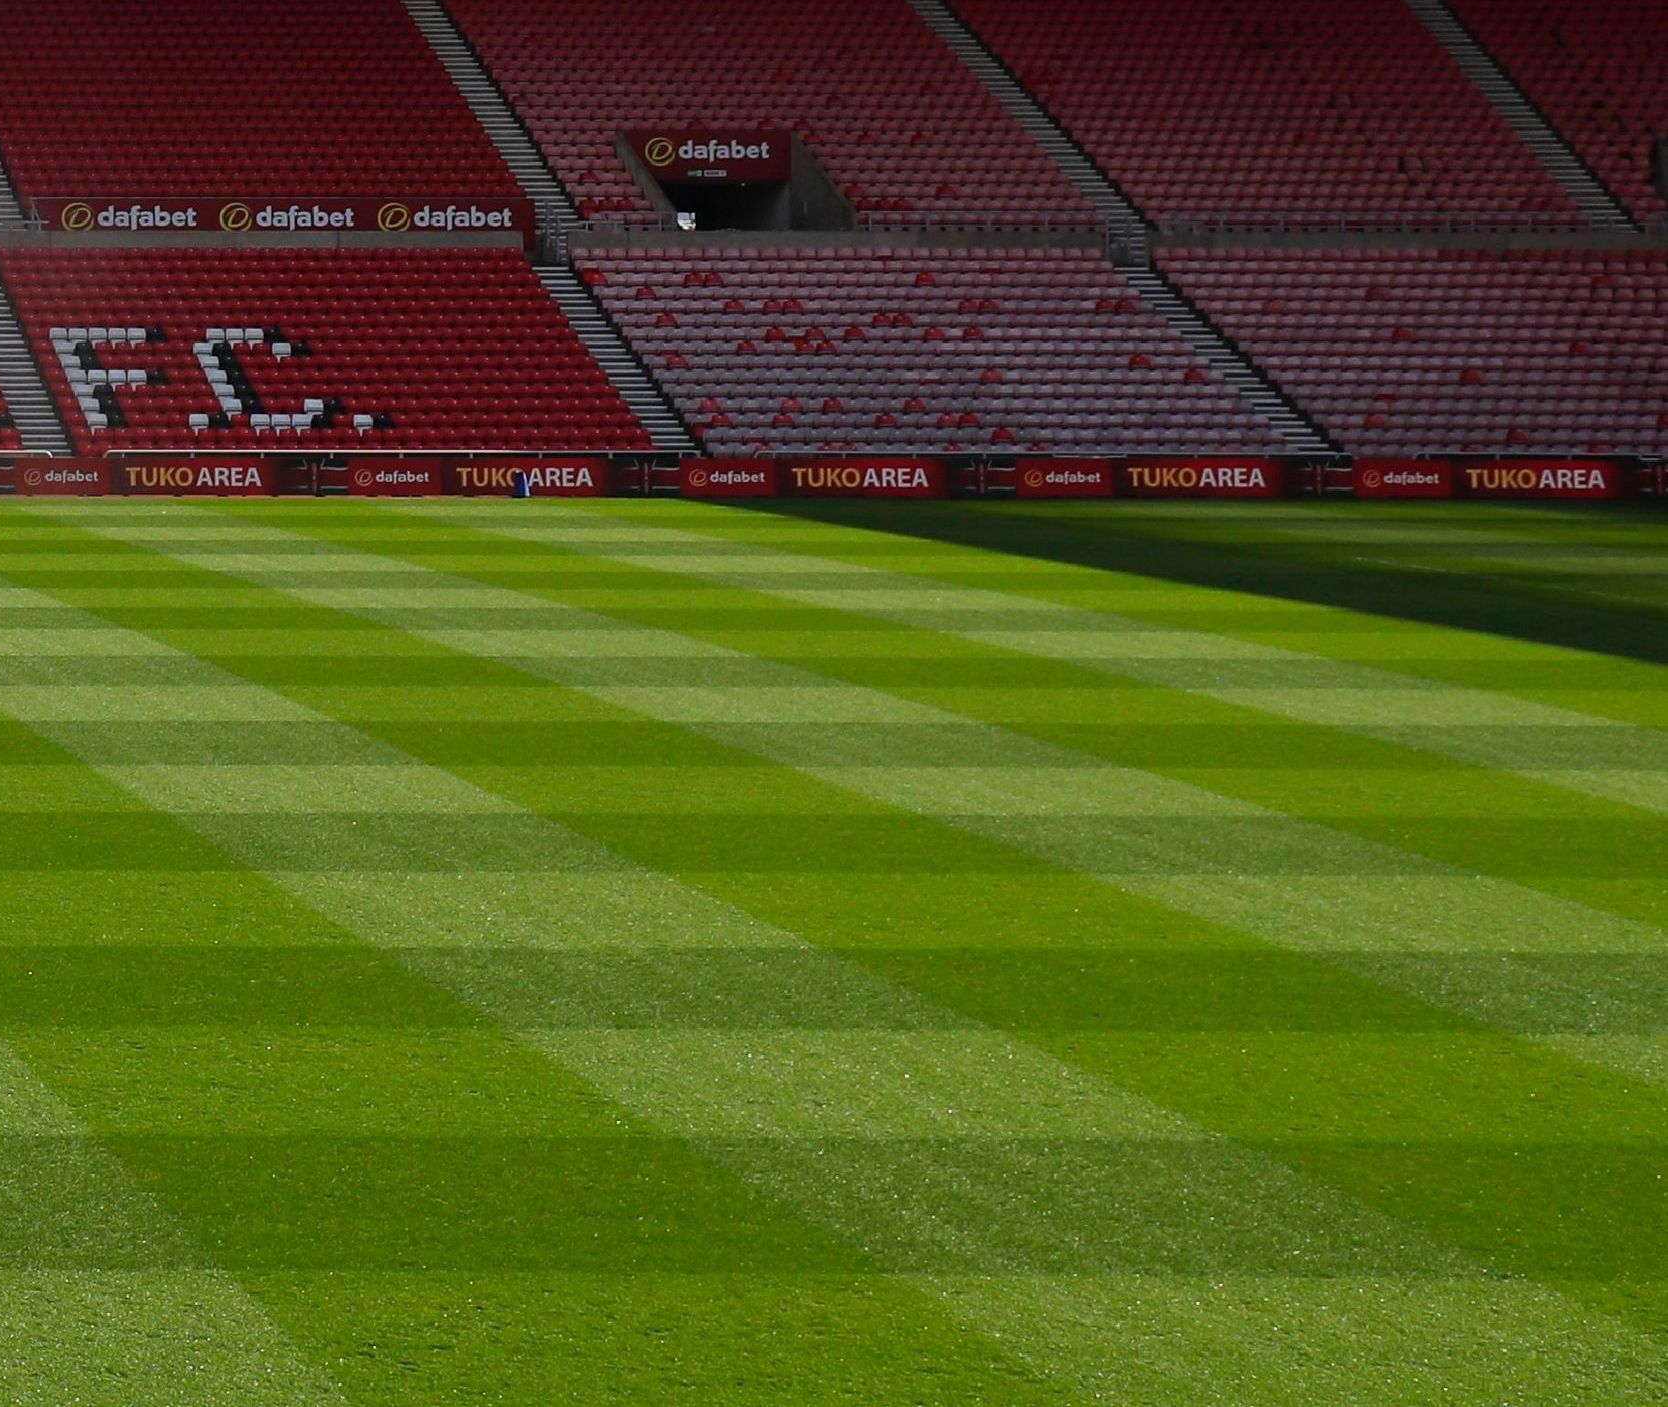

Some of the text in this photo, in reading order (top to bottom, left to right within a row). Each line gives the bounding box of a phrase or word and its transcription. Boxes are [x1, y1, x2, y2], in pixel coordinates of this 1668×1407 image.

[678, 139, 770, 163] dafabet
[97, 203, 197, 230] dafabet
[256, 203, 355, 230] dafabet
[413, 203, 512, 230] dafabet
[43, 469, 99, 485] dafabet
[375, 470, 430, 486] dafabet
[709, 470, 765, 486] dafabet
[1045, 471, 1101, 487] dafabet
[1383, 472, 1439, 488] dafabet
